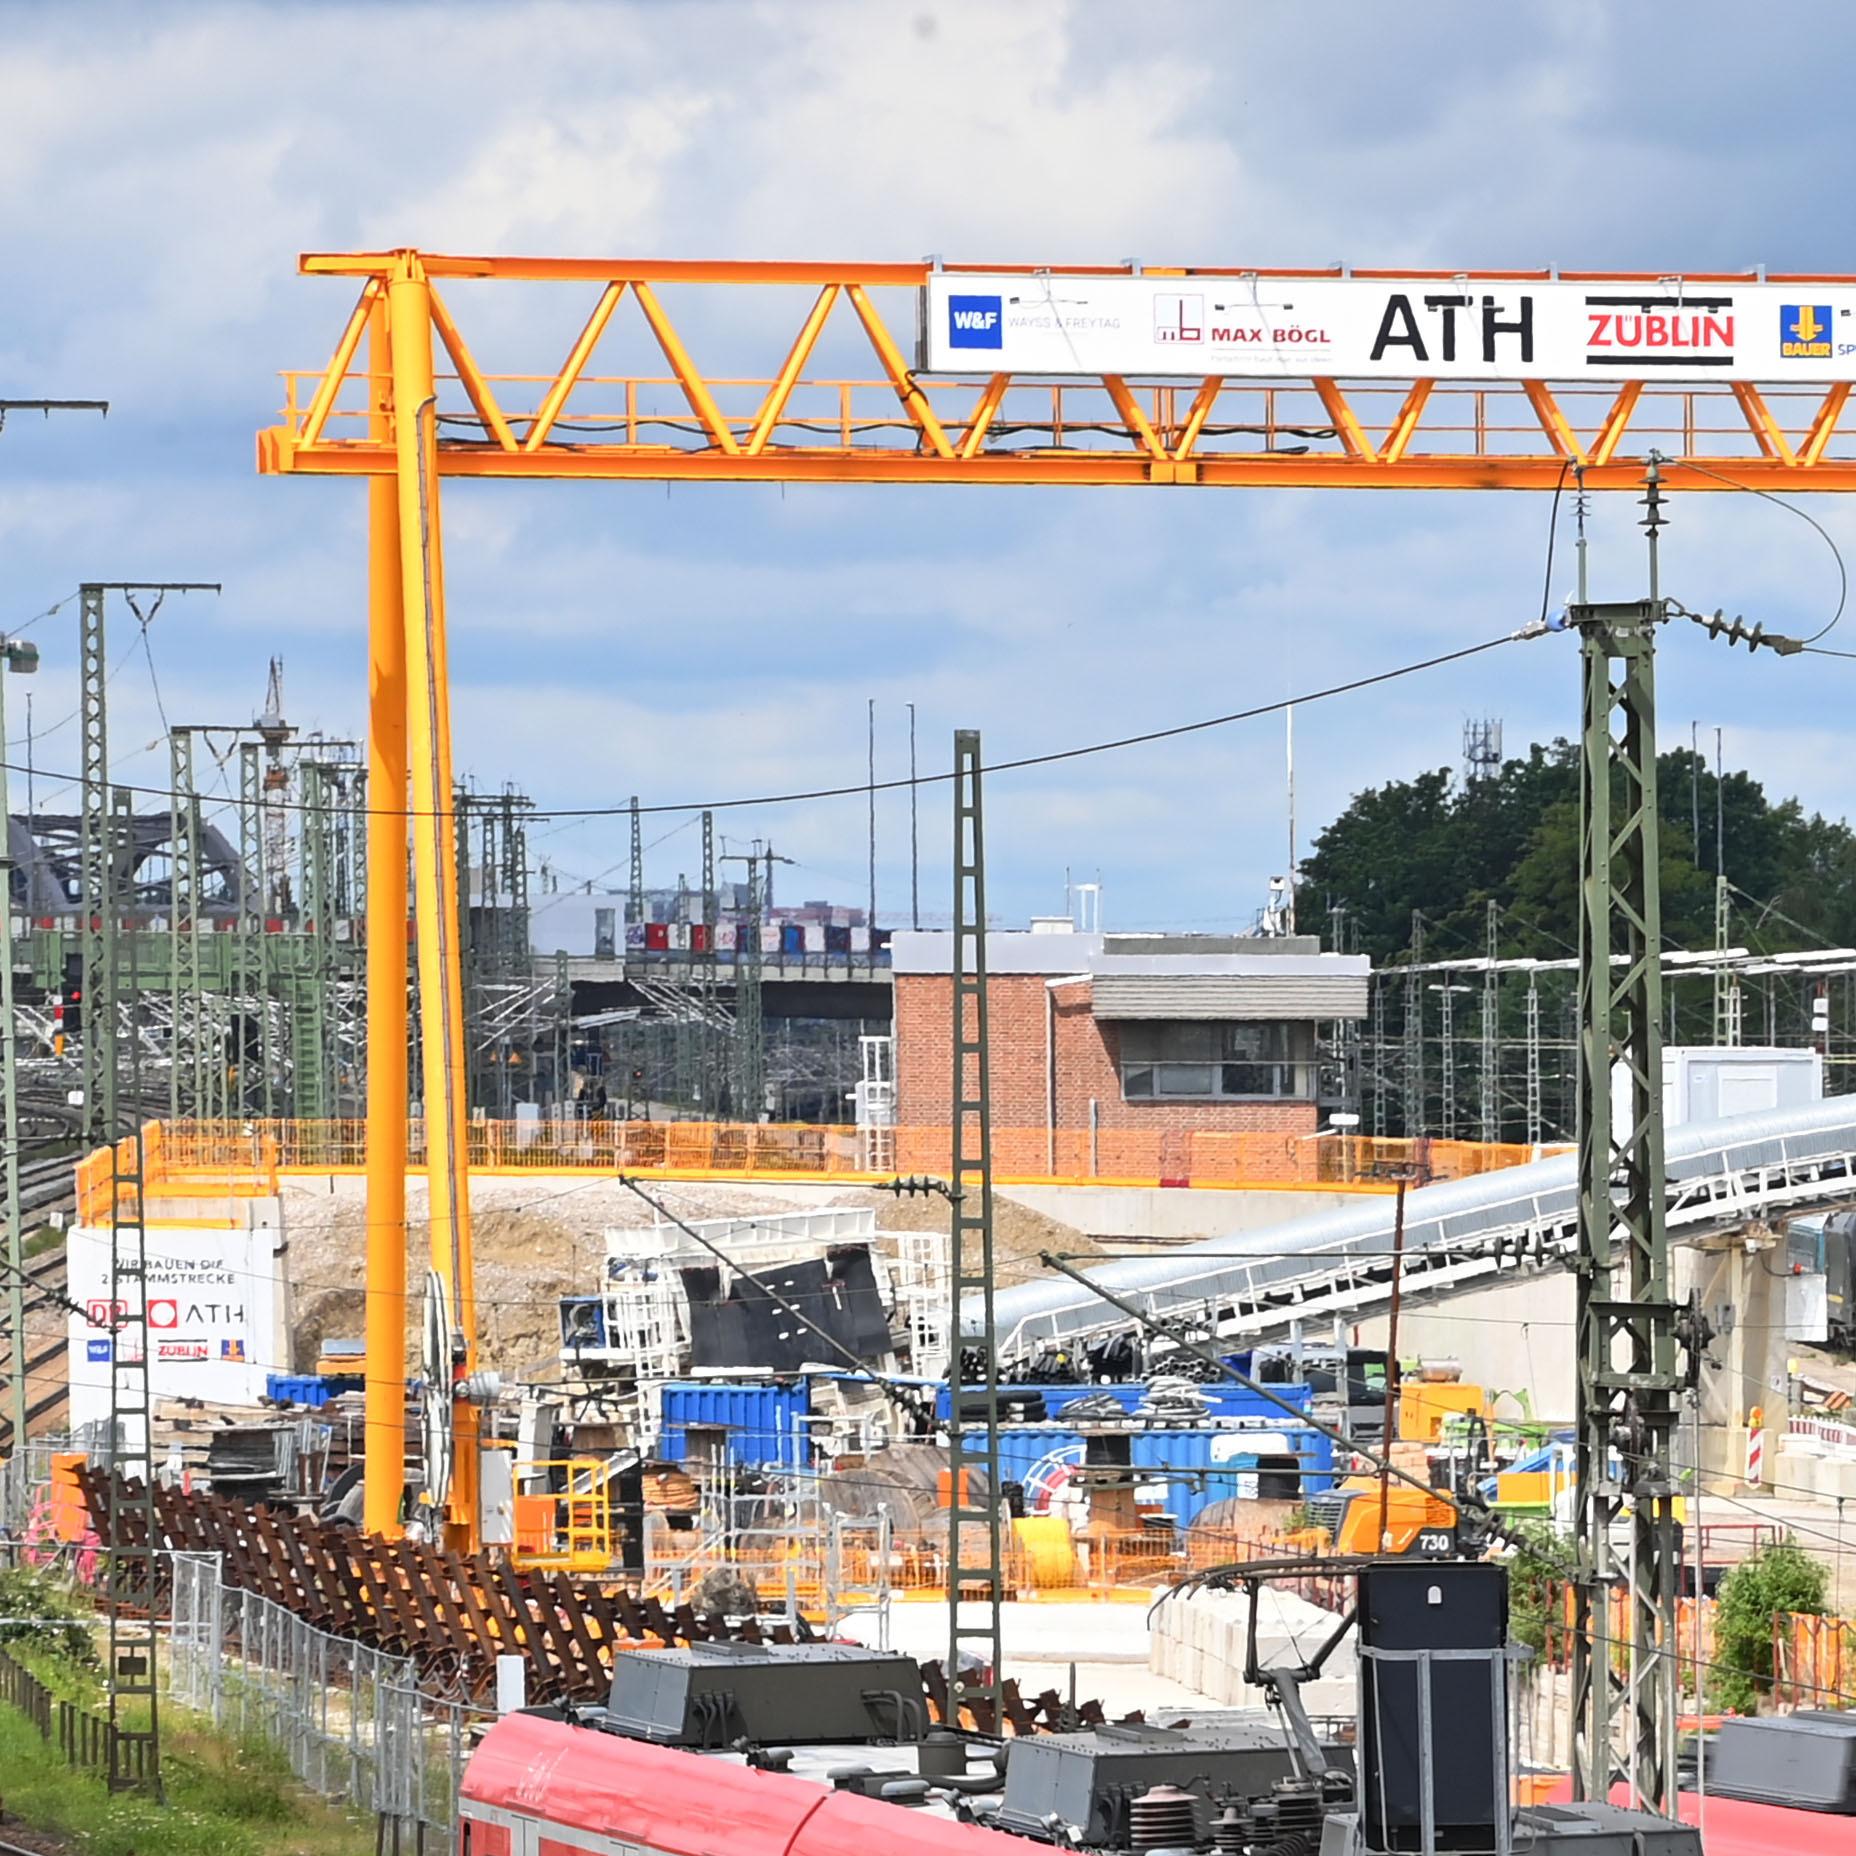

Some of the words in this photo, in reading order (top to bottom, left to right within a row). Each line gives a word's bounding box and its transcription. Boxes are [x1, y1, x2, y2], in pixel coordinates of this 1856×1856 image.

[954, 311, 998, 330] W&F
[1008, 317, 1051, 329] WAYSS
[1065, 317, 1121, 329] FREYTAG
[1369, 294, 1533, 362] ATH
[1211, 328, 1262, 342] MAX
[1273, 324, 1331, 343] BÖGL
[1586, 313, 1735, 348] ZÜBLIN
[1782, 342, 1832, 357] BAUER
[186, 1303, 244, 1324] ATH
[1419, 1534, 1450, 1551] 730
